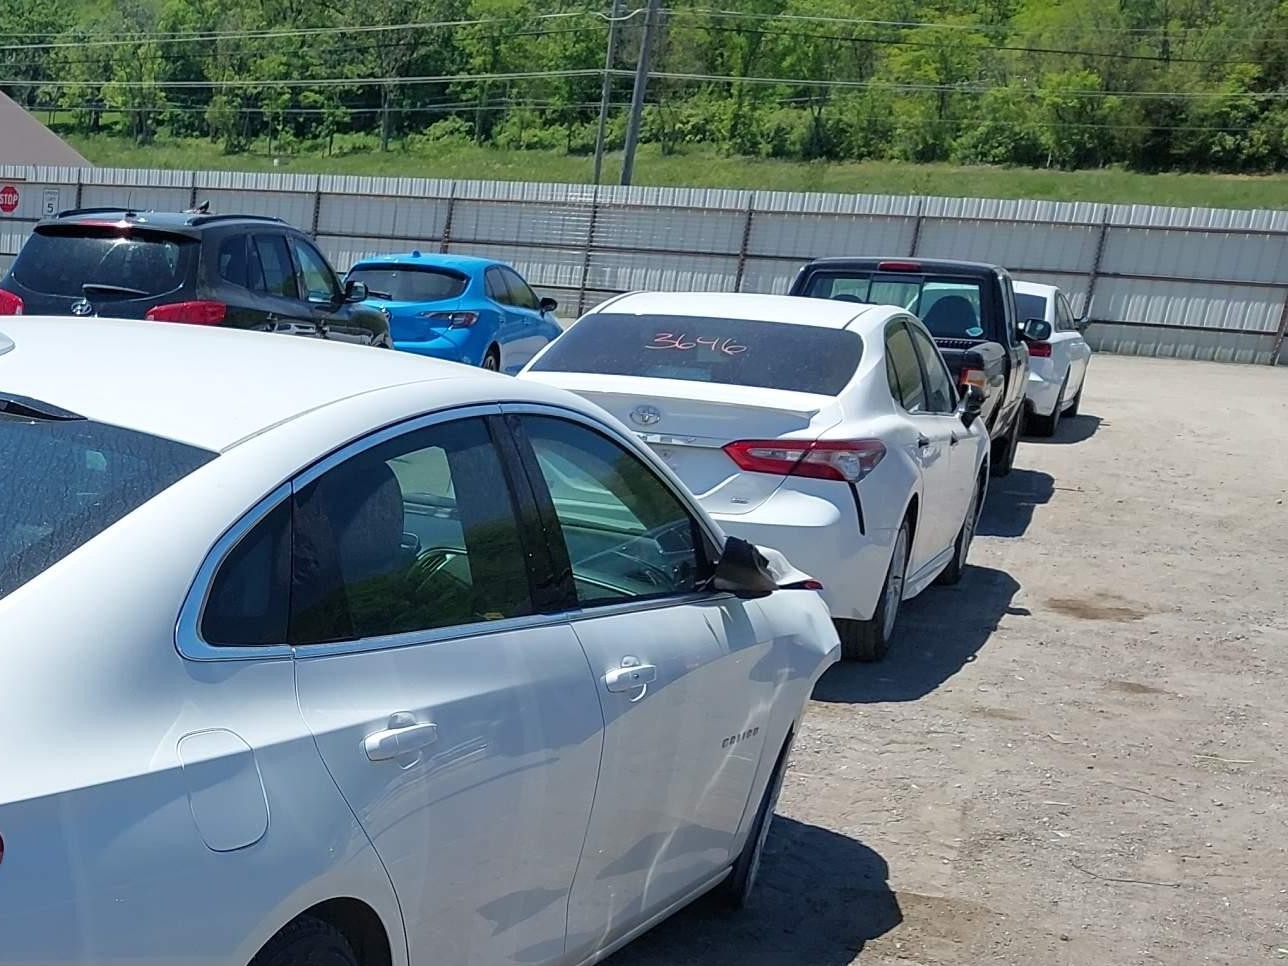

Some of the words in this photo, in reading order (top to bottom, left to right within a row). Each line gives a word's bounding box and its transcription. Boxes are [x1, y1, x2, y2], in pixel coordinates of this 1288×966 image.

[0, 193, 19, 205] STOP
[47, 203, 54, 213] 5
[644, 332, 747, 355] 3646
